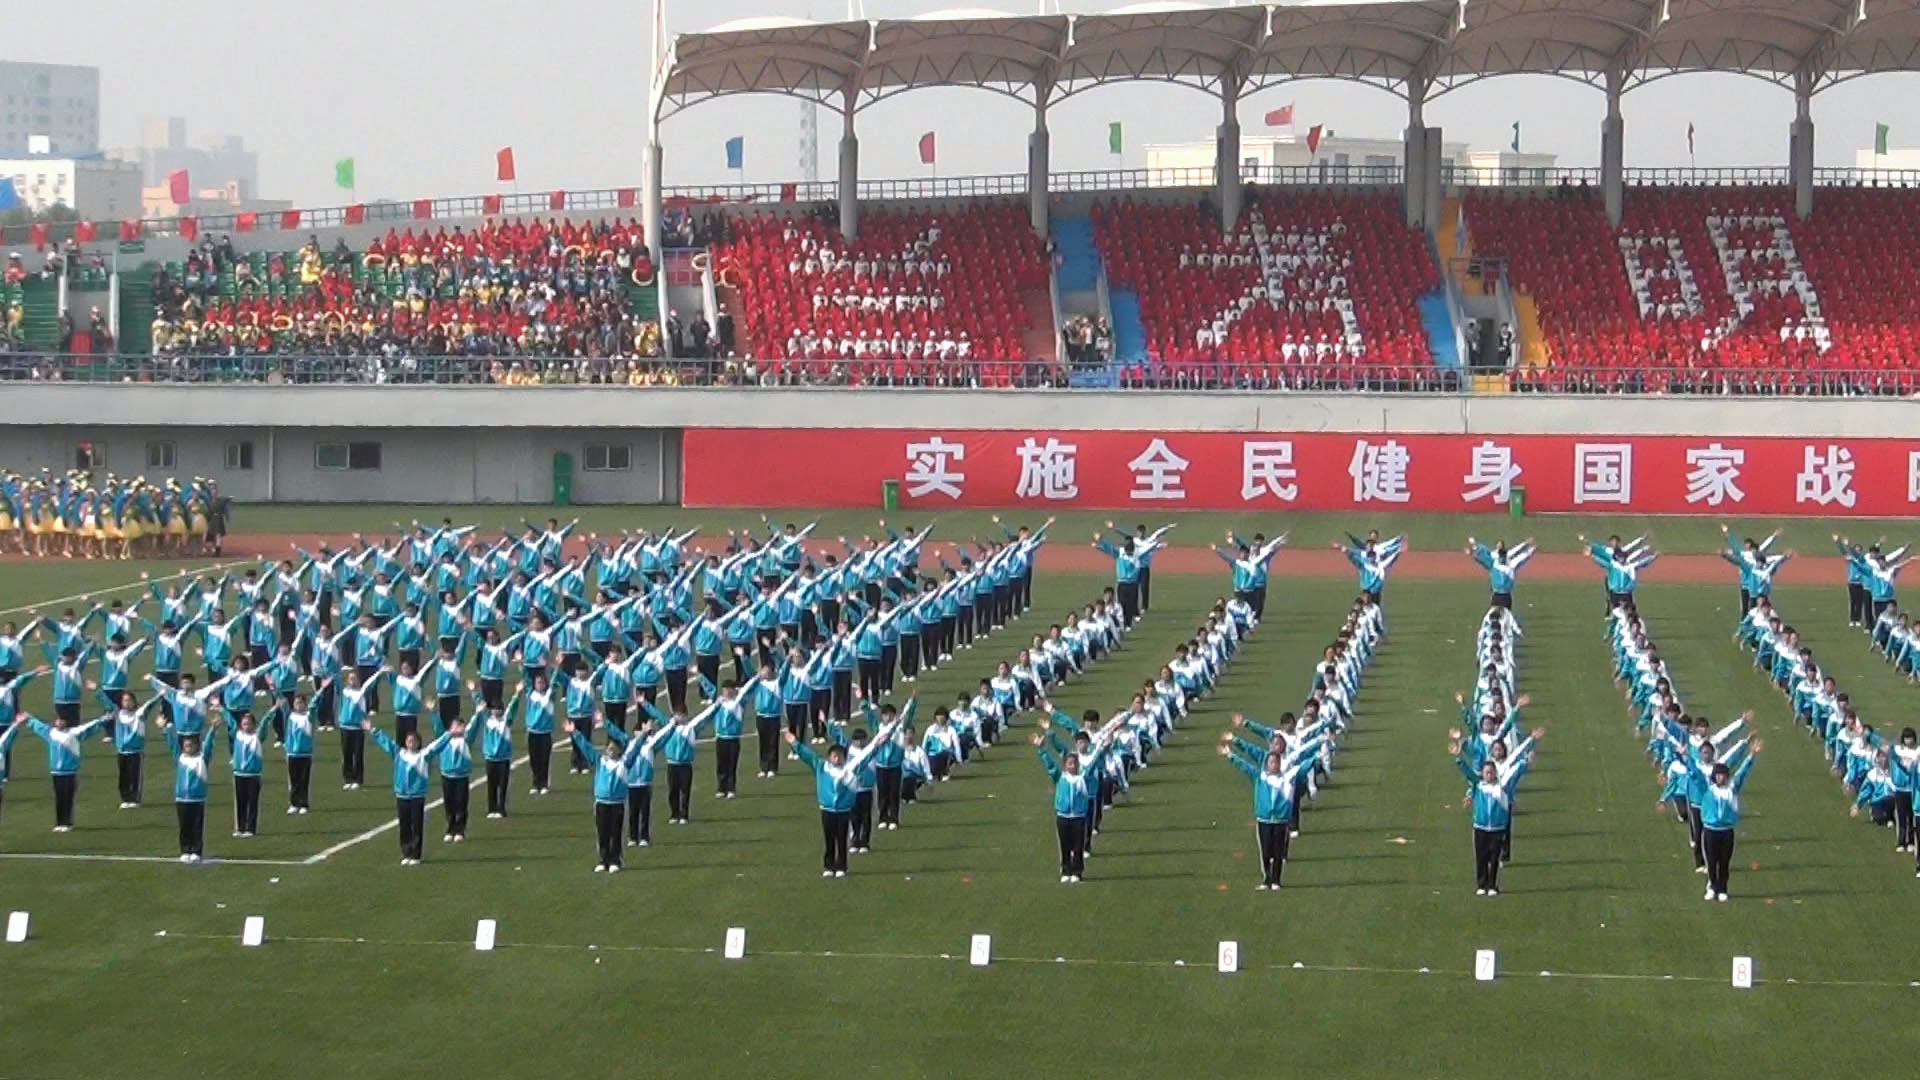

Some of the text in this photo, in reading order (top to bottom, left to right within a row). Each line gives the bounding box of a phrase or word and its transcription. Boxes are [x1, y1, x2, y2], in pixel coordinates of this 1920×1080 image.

[905, 436, 1920, 508] 实施全民健身国家战
[1223, 947, 1233, 966] 6
[1480, 956, 1490, 974] 7
[1736, 963, 1747, 982] 8
